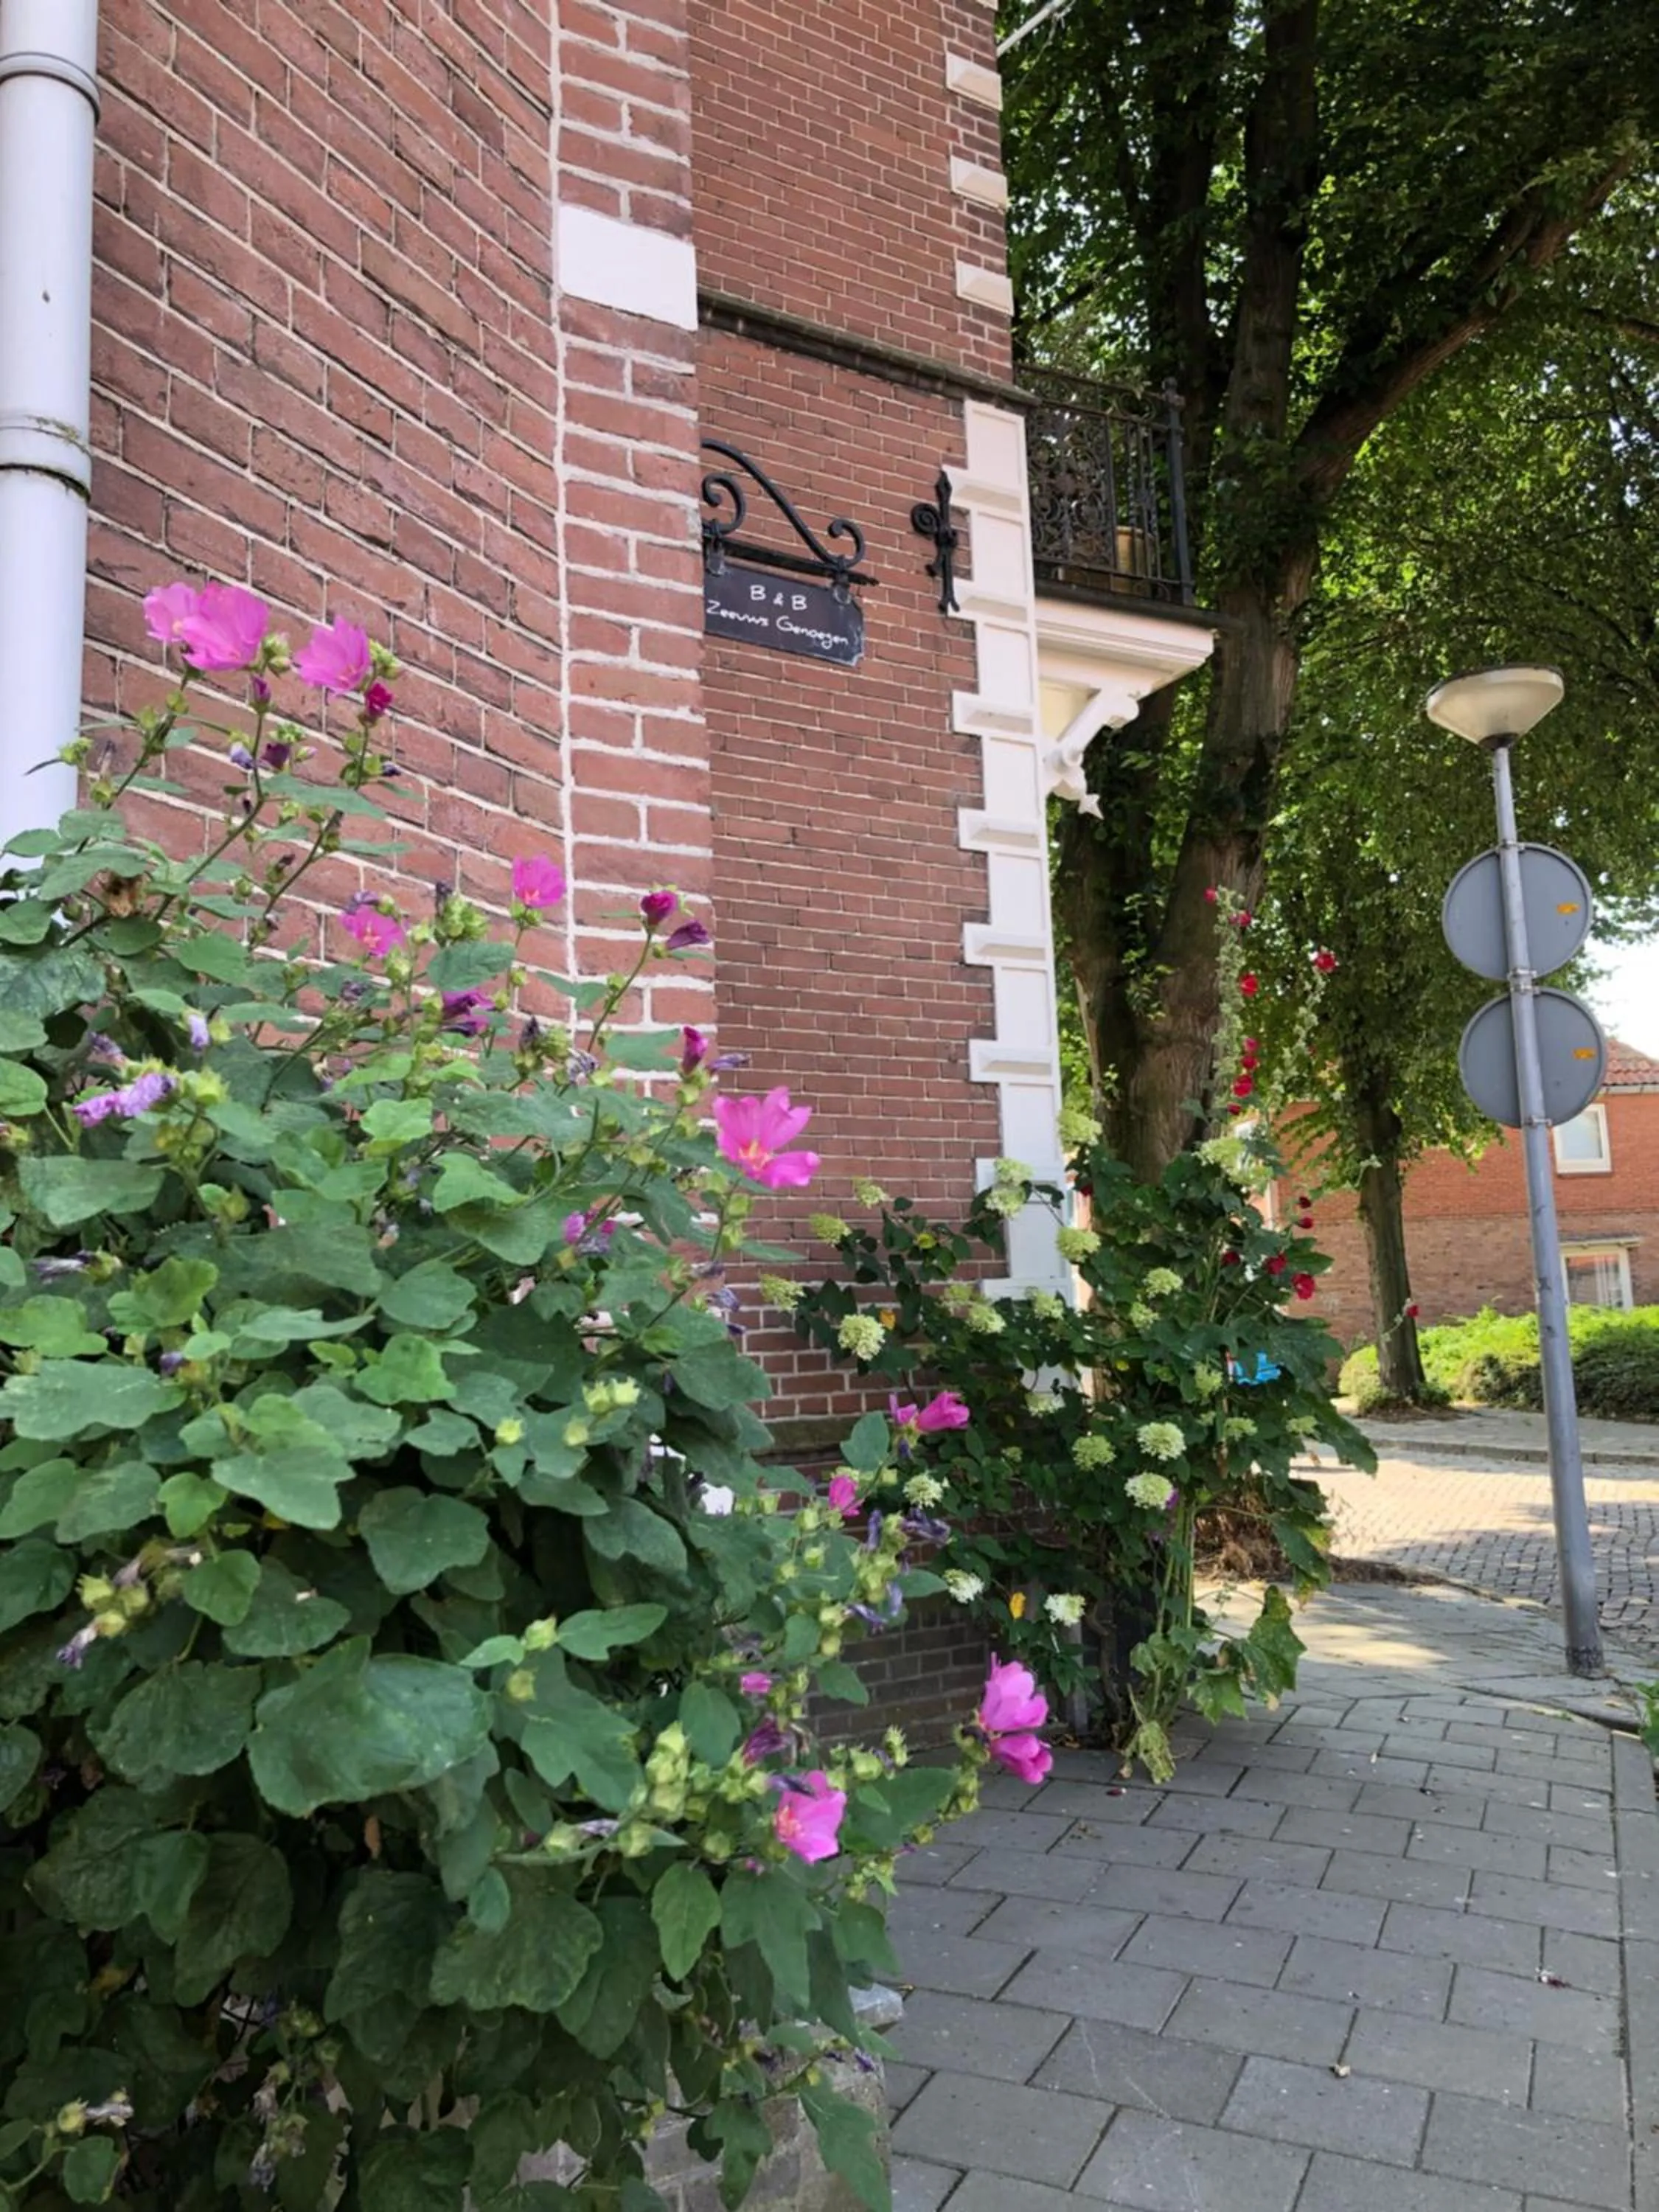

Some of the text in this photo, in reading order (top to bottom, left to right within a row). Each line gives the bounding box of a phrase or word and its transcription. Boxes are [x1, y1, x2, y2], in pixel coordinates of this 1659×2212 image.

[750, 585, 807, 611] B & B
[706, 599, 848, 649] Zeeuws Genoegen
